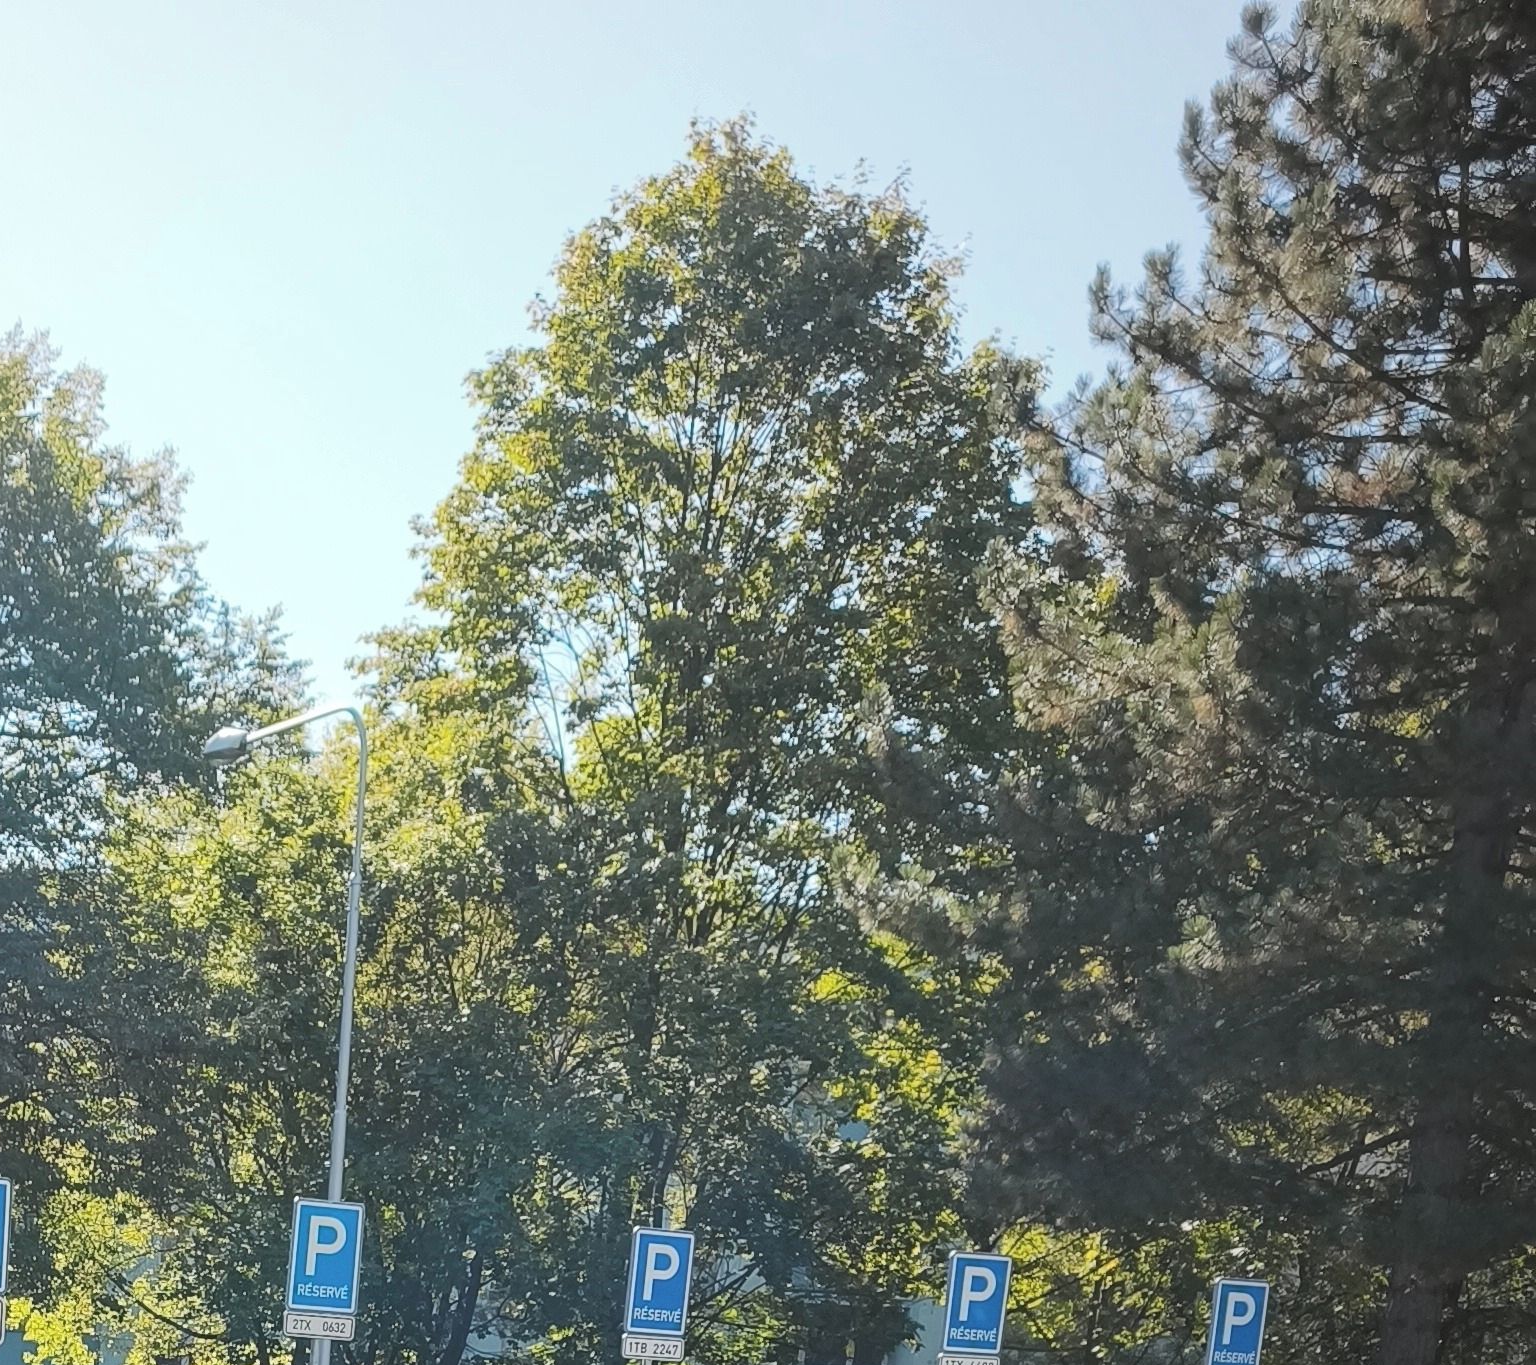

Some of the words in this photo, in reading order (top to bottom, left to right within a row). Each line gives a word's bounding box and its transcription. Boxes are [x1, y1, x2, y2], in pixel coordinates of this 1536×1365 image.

[305, 1215, 346, 1276] P
[643, 1243, 680, 1301] P
[297, 1282, 348, 1299] RÉSERVÉ
[959, 1266, 996, 1321] P
[633, 1306, 681, 1323] RÉSERVÉ
[1222, 1292, 1256, 1345] P
[293, 1319, 311, 1331] 2TX
[323, 1321, 345, 1333] 0632
[950, 1326, 997, 1342] RÉSERVÉ
[629, 1342, 647, 1353] 1TB
[653, 1344, 678, 1356] 2247
[1214, 1349, 1256, 1365] RÉSERVÉ
